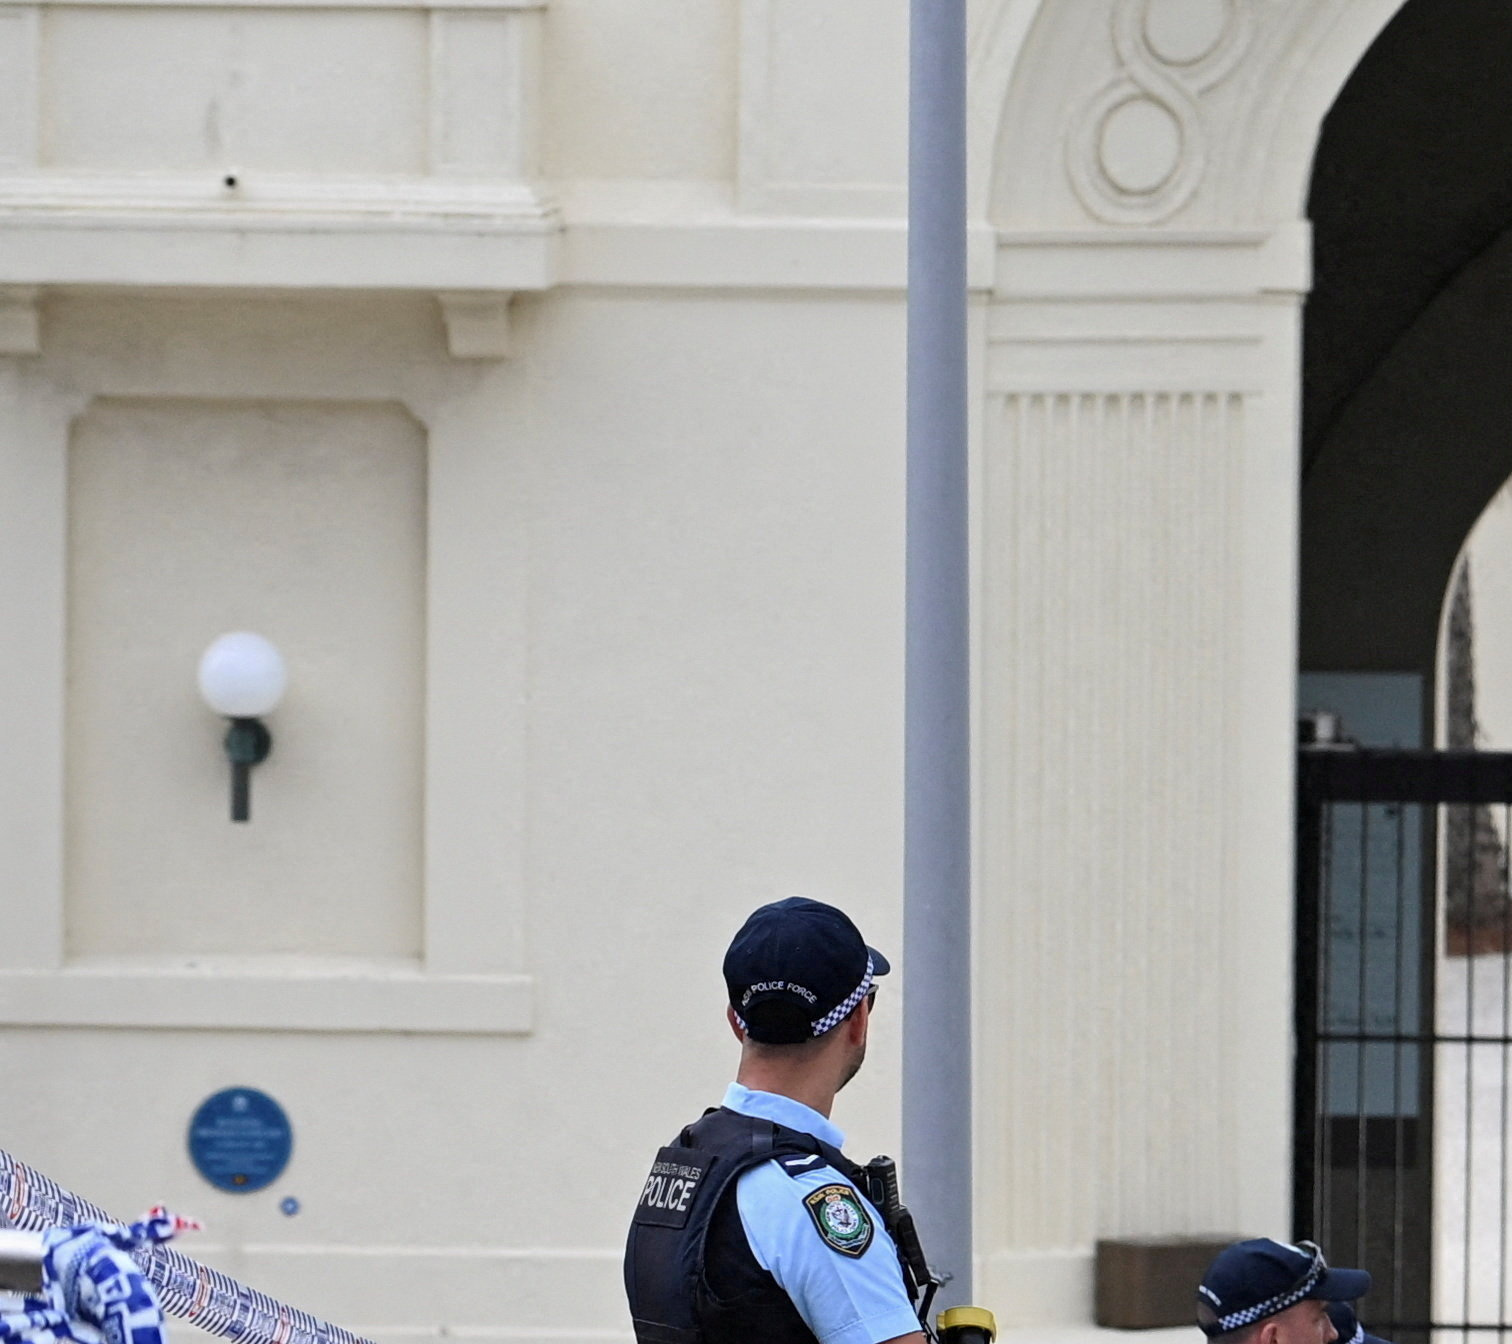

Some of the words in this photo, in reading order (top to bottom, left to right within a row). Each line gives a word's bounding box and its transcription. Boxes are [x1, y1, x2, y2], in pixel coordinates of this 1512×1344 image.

[751, 981, 784, 994] POLICE
[786, 982, 818, 1004] FORCE
[640, 1175, 696, 1212] POLICE
